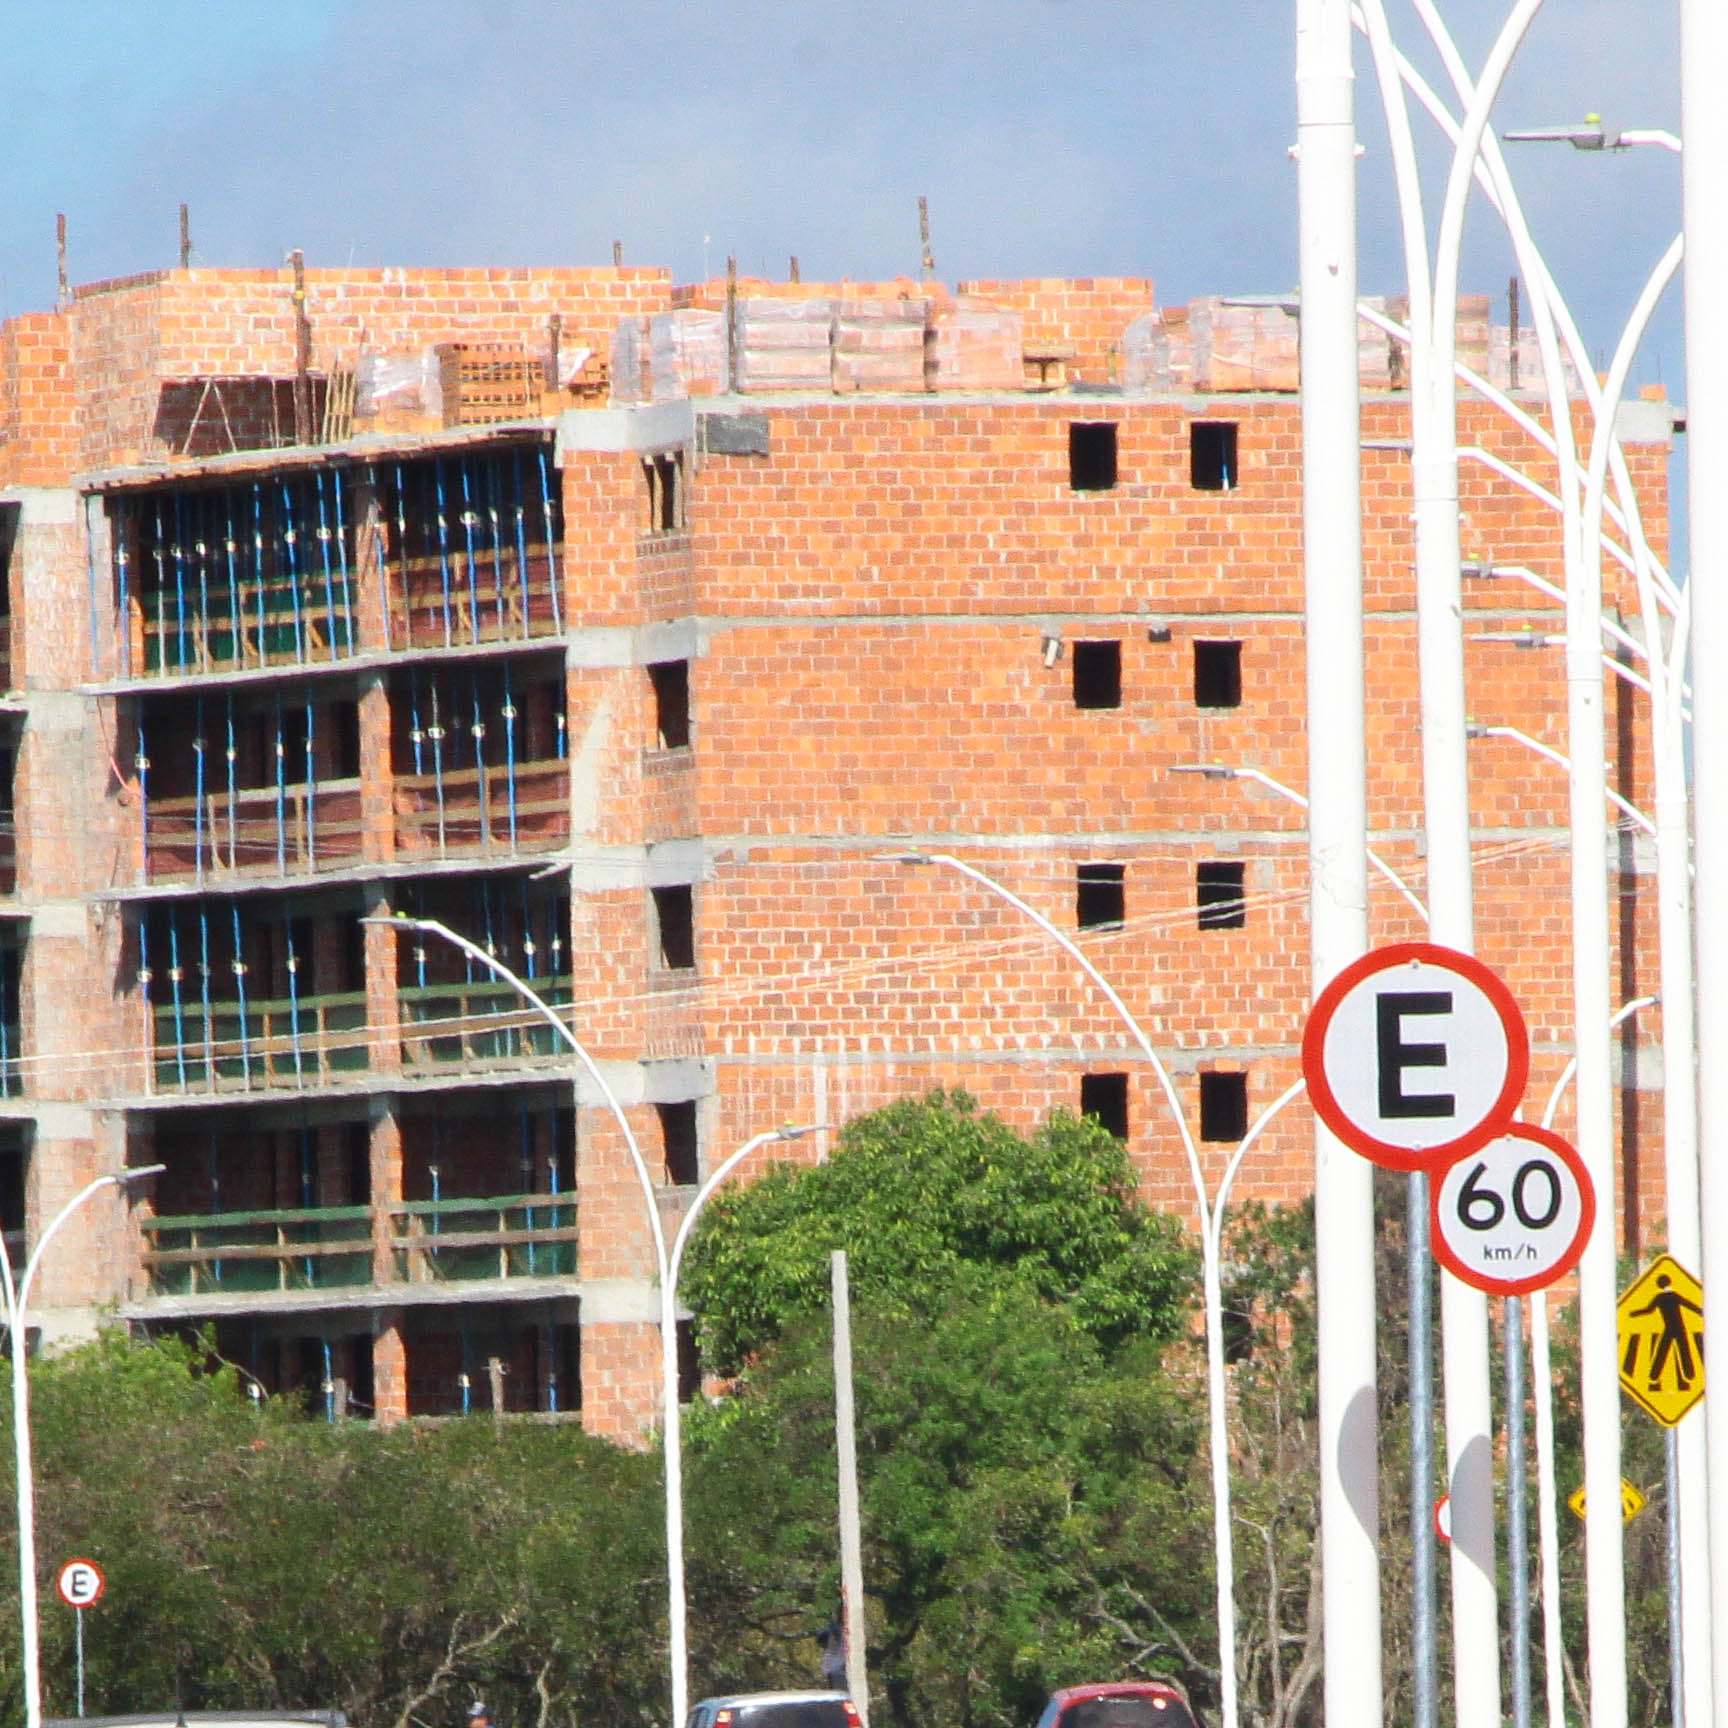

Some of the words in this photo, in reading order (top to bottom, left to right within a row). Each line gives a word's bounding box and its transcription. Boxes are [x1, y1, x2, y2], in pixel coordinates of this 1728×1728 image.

[1376, 991, 1456, 1119] E
[1456, 1159, 1562, 1232] 60
[1483, 1243, 1538, 1260] km/h
[71, 1569, 89, 1597] E
